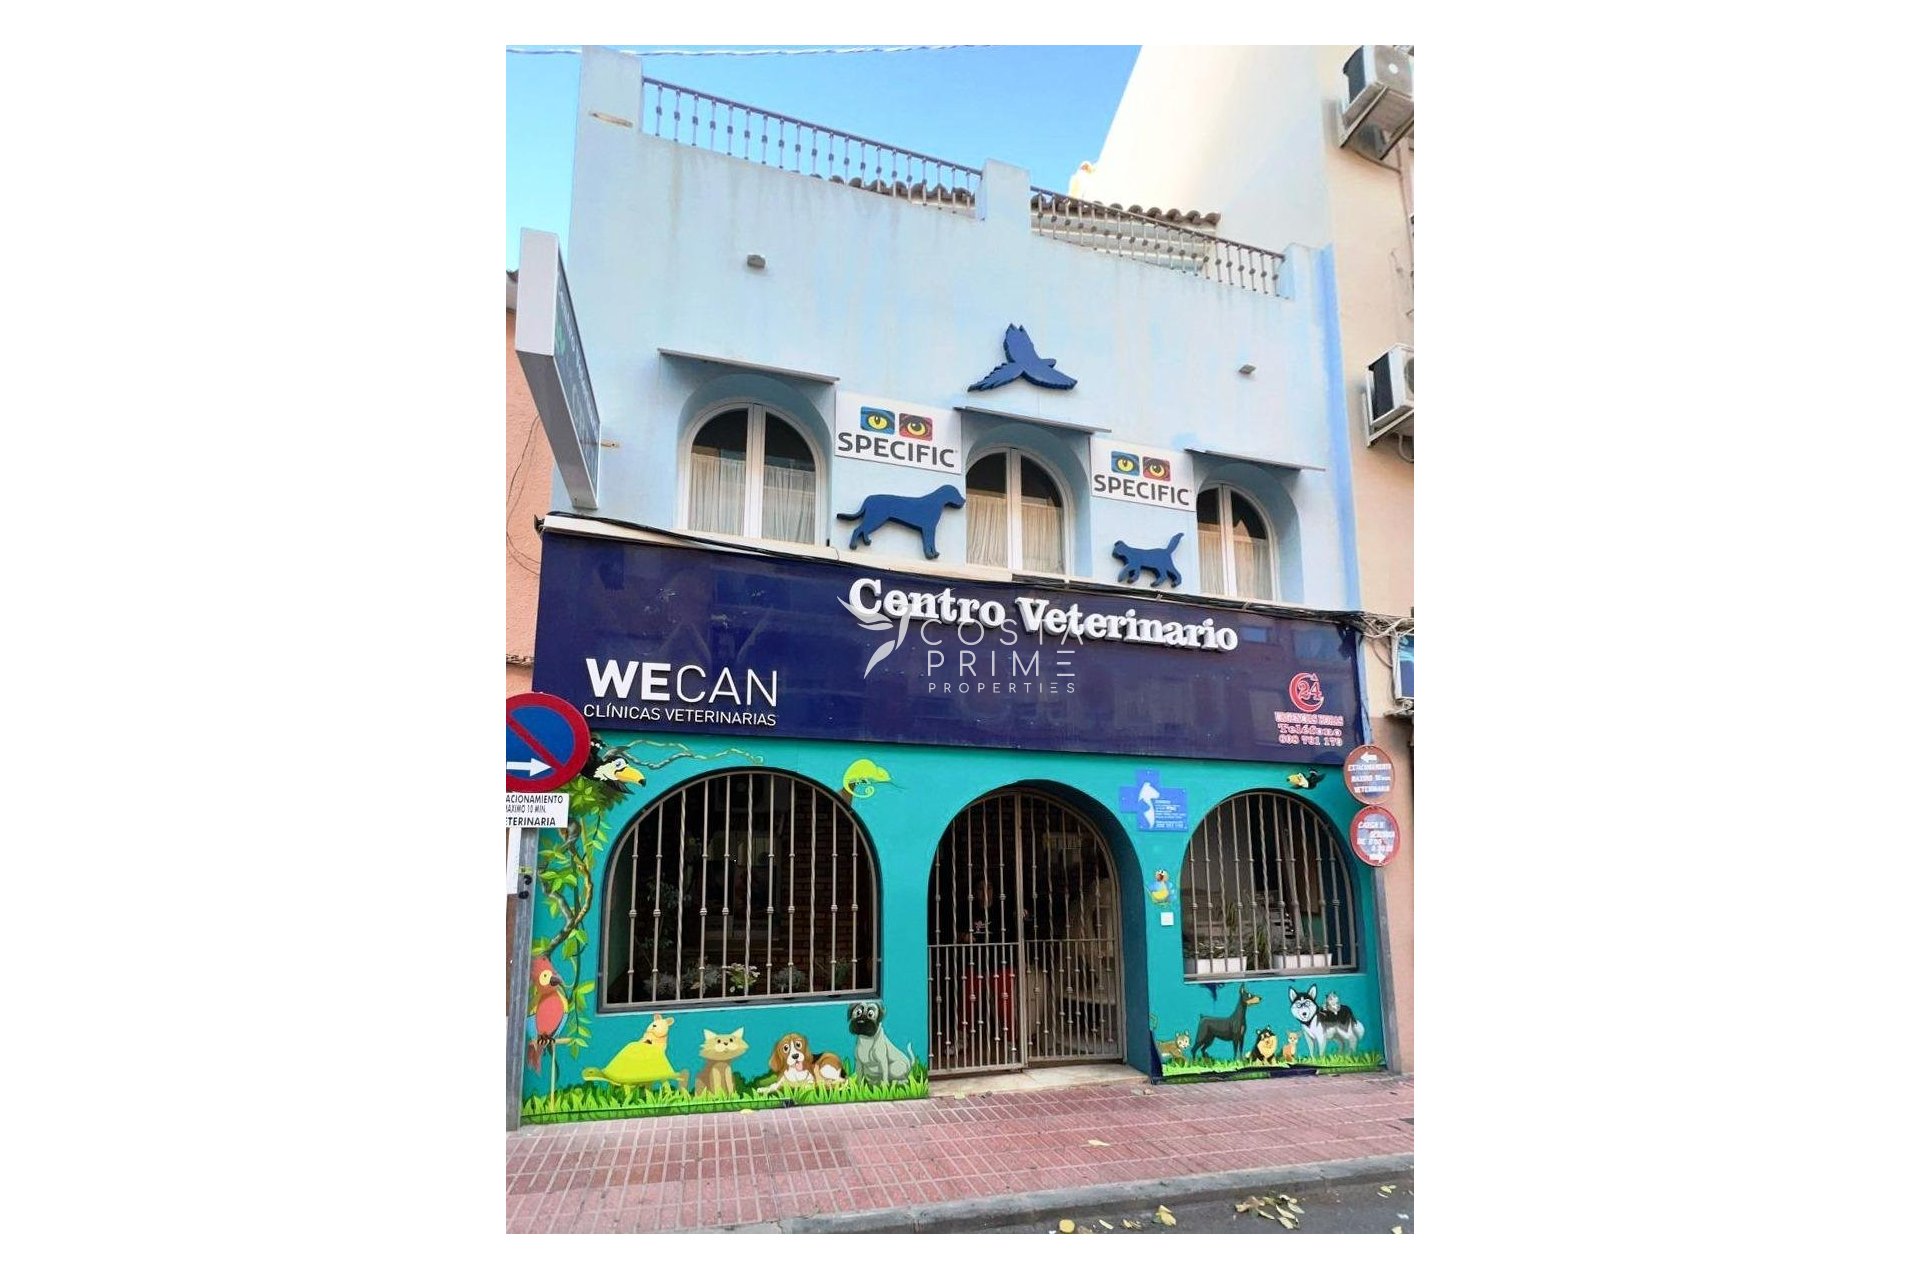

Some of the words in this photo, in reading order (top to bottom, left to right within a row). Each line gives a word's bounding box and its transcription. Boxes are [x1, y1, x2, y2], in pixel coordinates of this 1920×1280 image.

[838, 432, 955, 468] SPECIFIC
[1093, 474, 1190, 506] SPECIFIC
[849, 577, 1006, 629] Centro
[1015, 597, 1239, 652] Veterinario
[1297, 680, 1323, 701] 24
[583, 702, 661, 721] CLÍNICAS
[665, 708, 776, 727] VETERINARIAS
